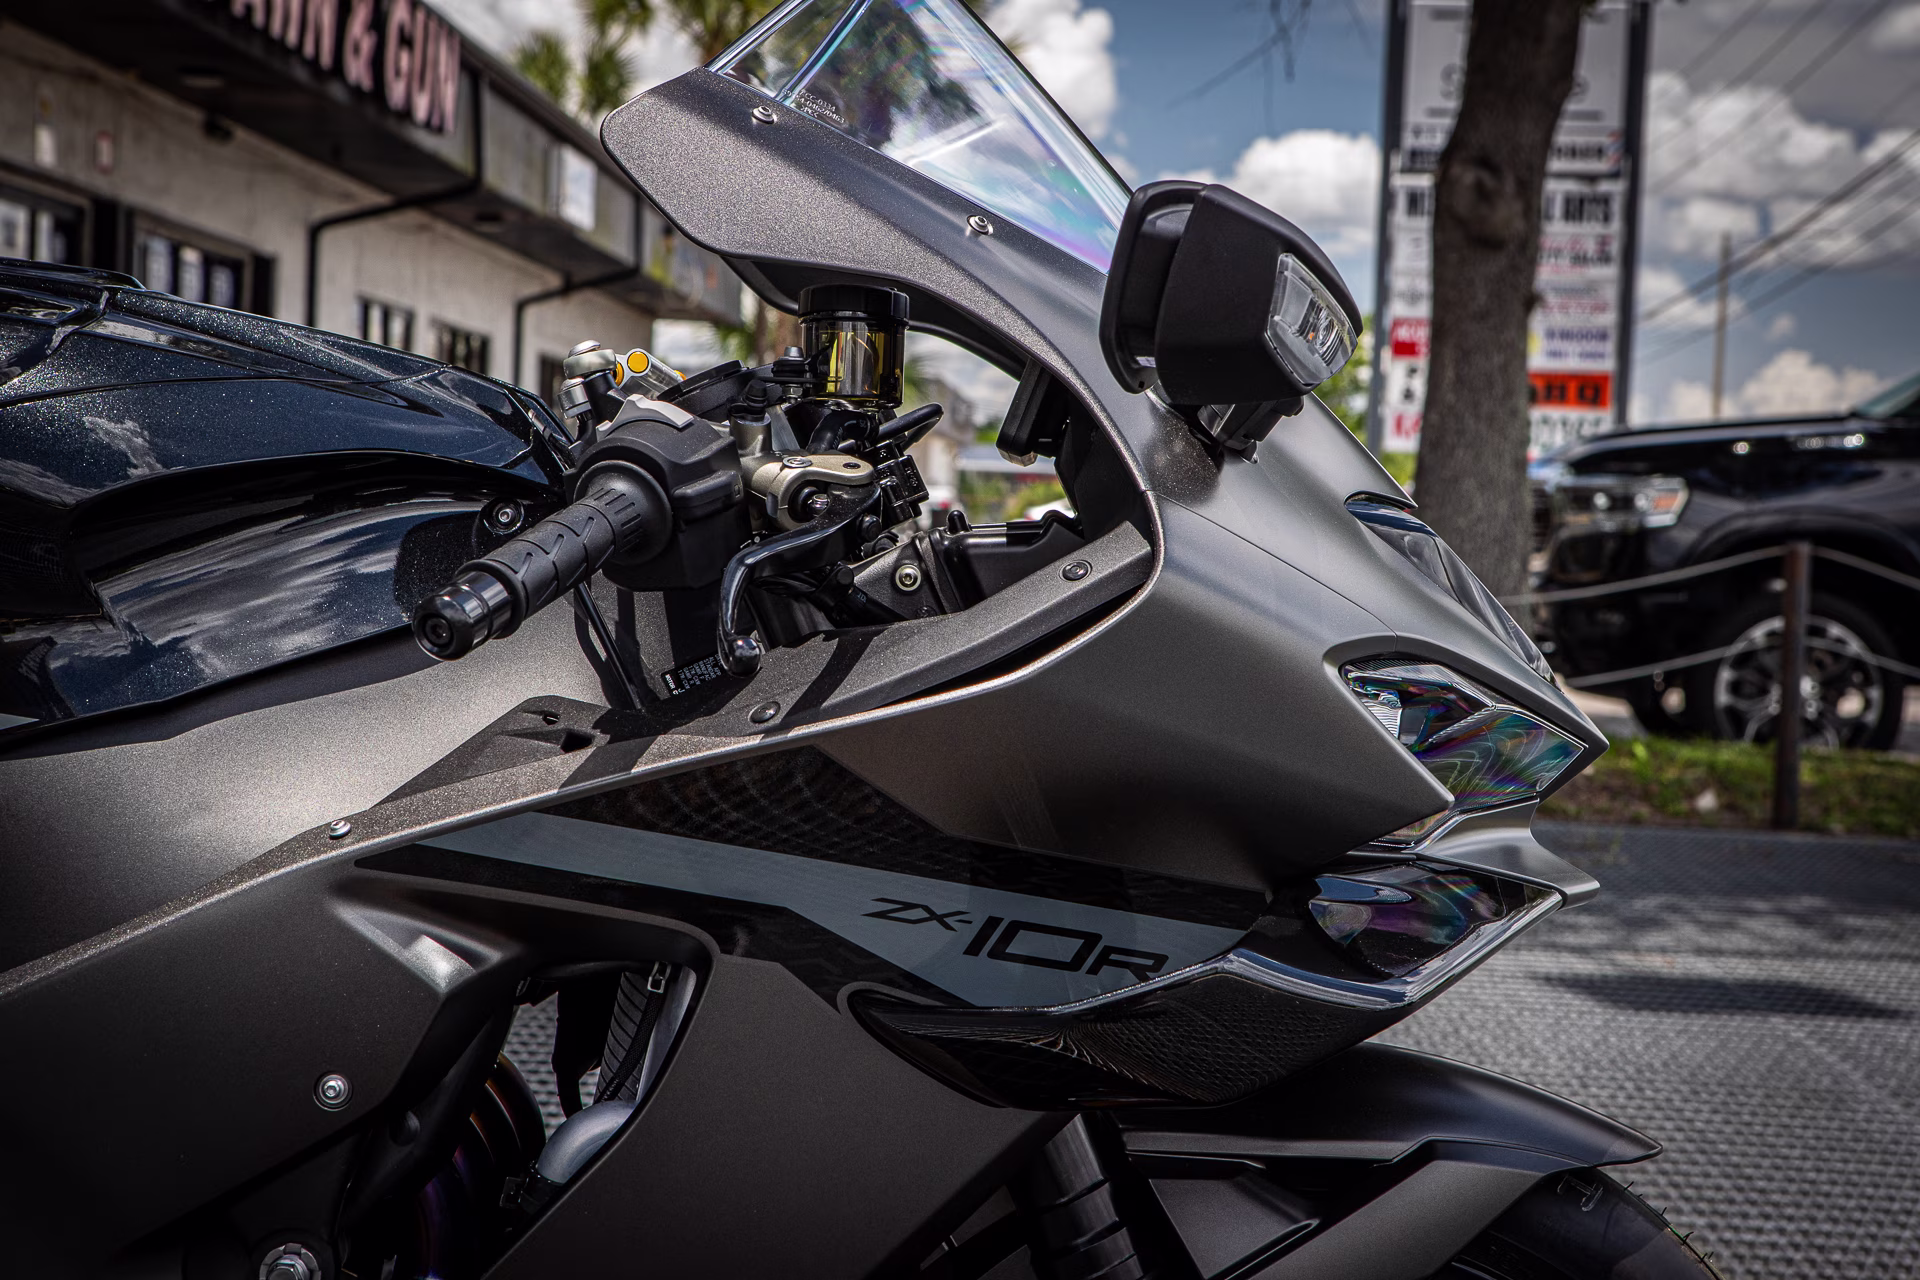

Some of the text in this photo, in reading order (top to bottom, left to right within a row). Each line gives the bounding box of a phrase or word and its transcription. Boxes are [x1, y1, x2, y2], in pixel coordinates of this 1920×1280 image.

[342, 0, 378, 93] &
[384, 0, 461, 133] GUN
[861, 896, 1169, 982] ZX-10R
